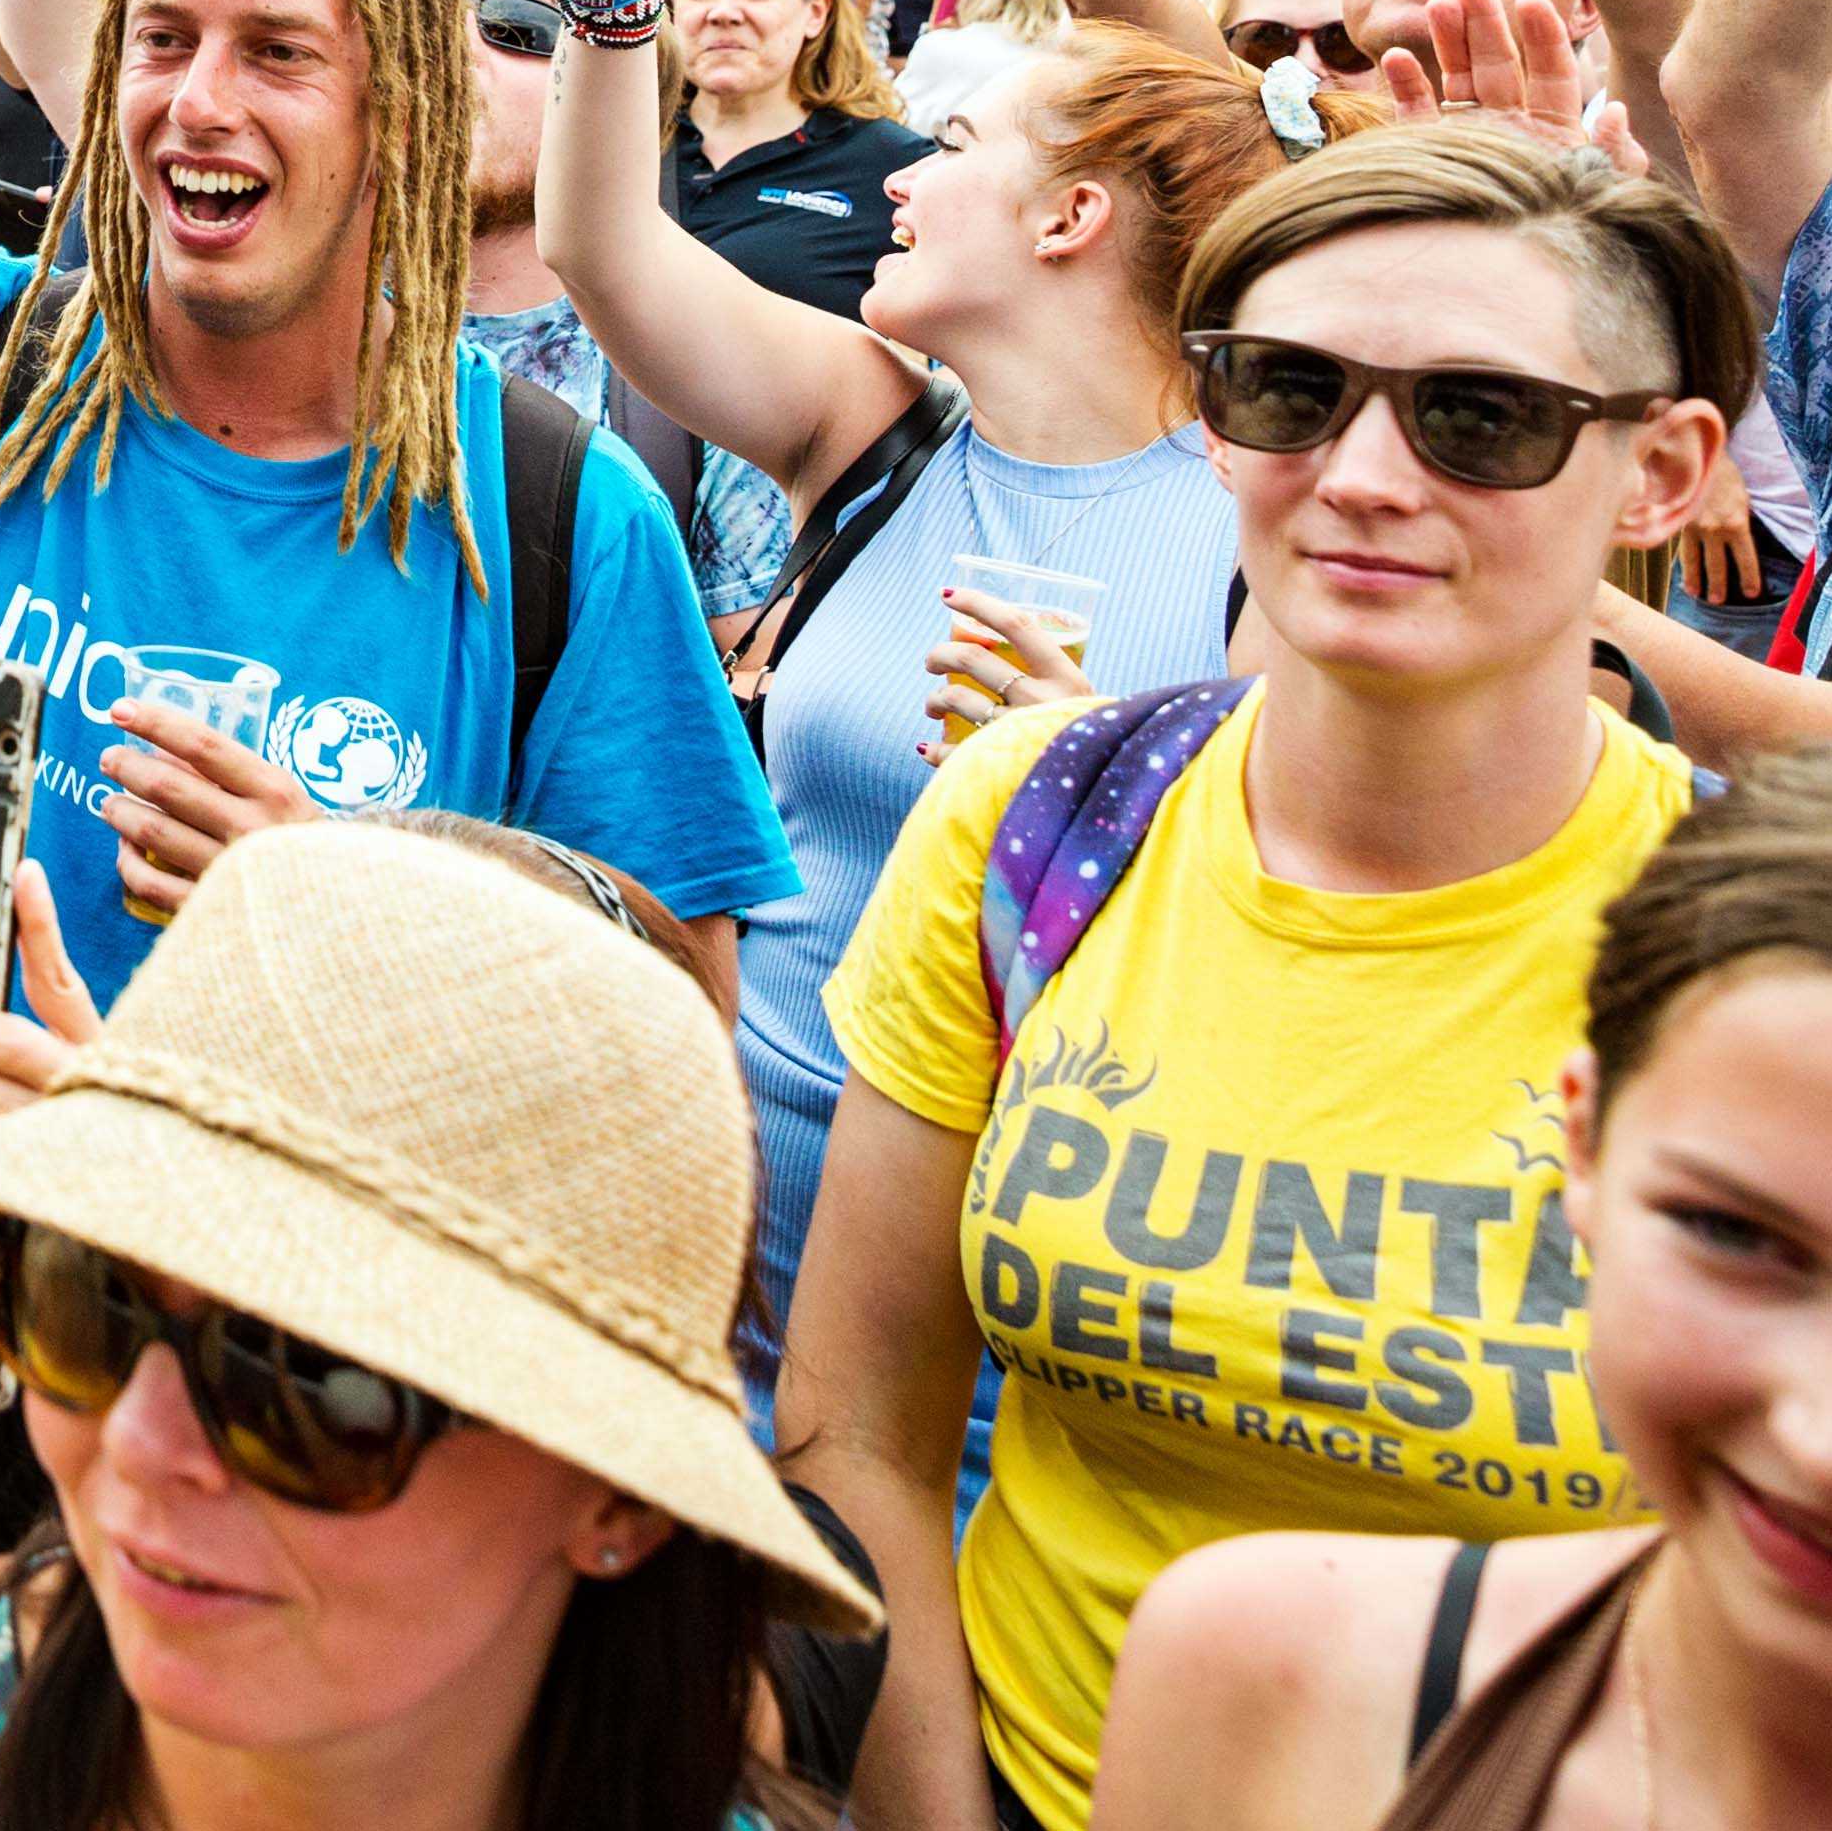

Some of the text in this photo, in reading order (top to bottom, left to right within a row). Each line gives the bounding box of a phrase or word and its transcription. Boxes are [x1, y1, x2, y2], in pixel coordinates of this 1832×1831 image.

[34, 749, 114, 817] KING
[992, 1104, 1591, 1327] PUNTA
[980, 1231, 1624, 1453] DEL EST
[989, 1331, 1657, 1511] CLIPPER RACE 2019/
